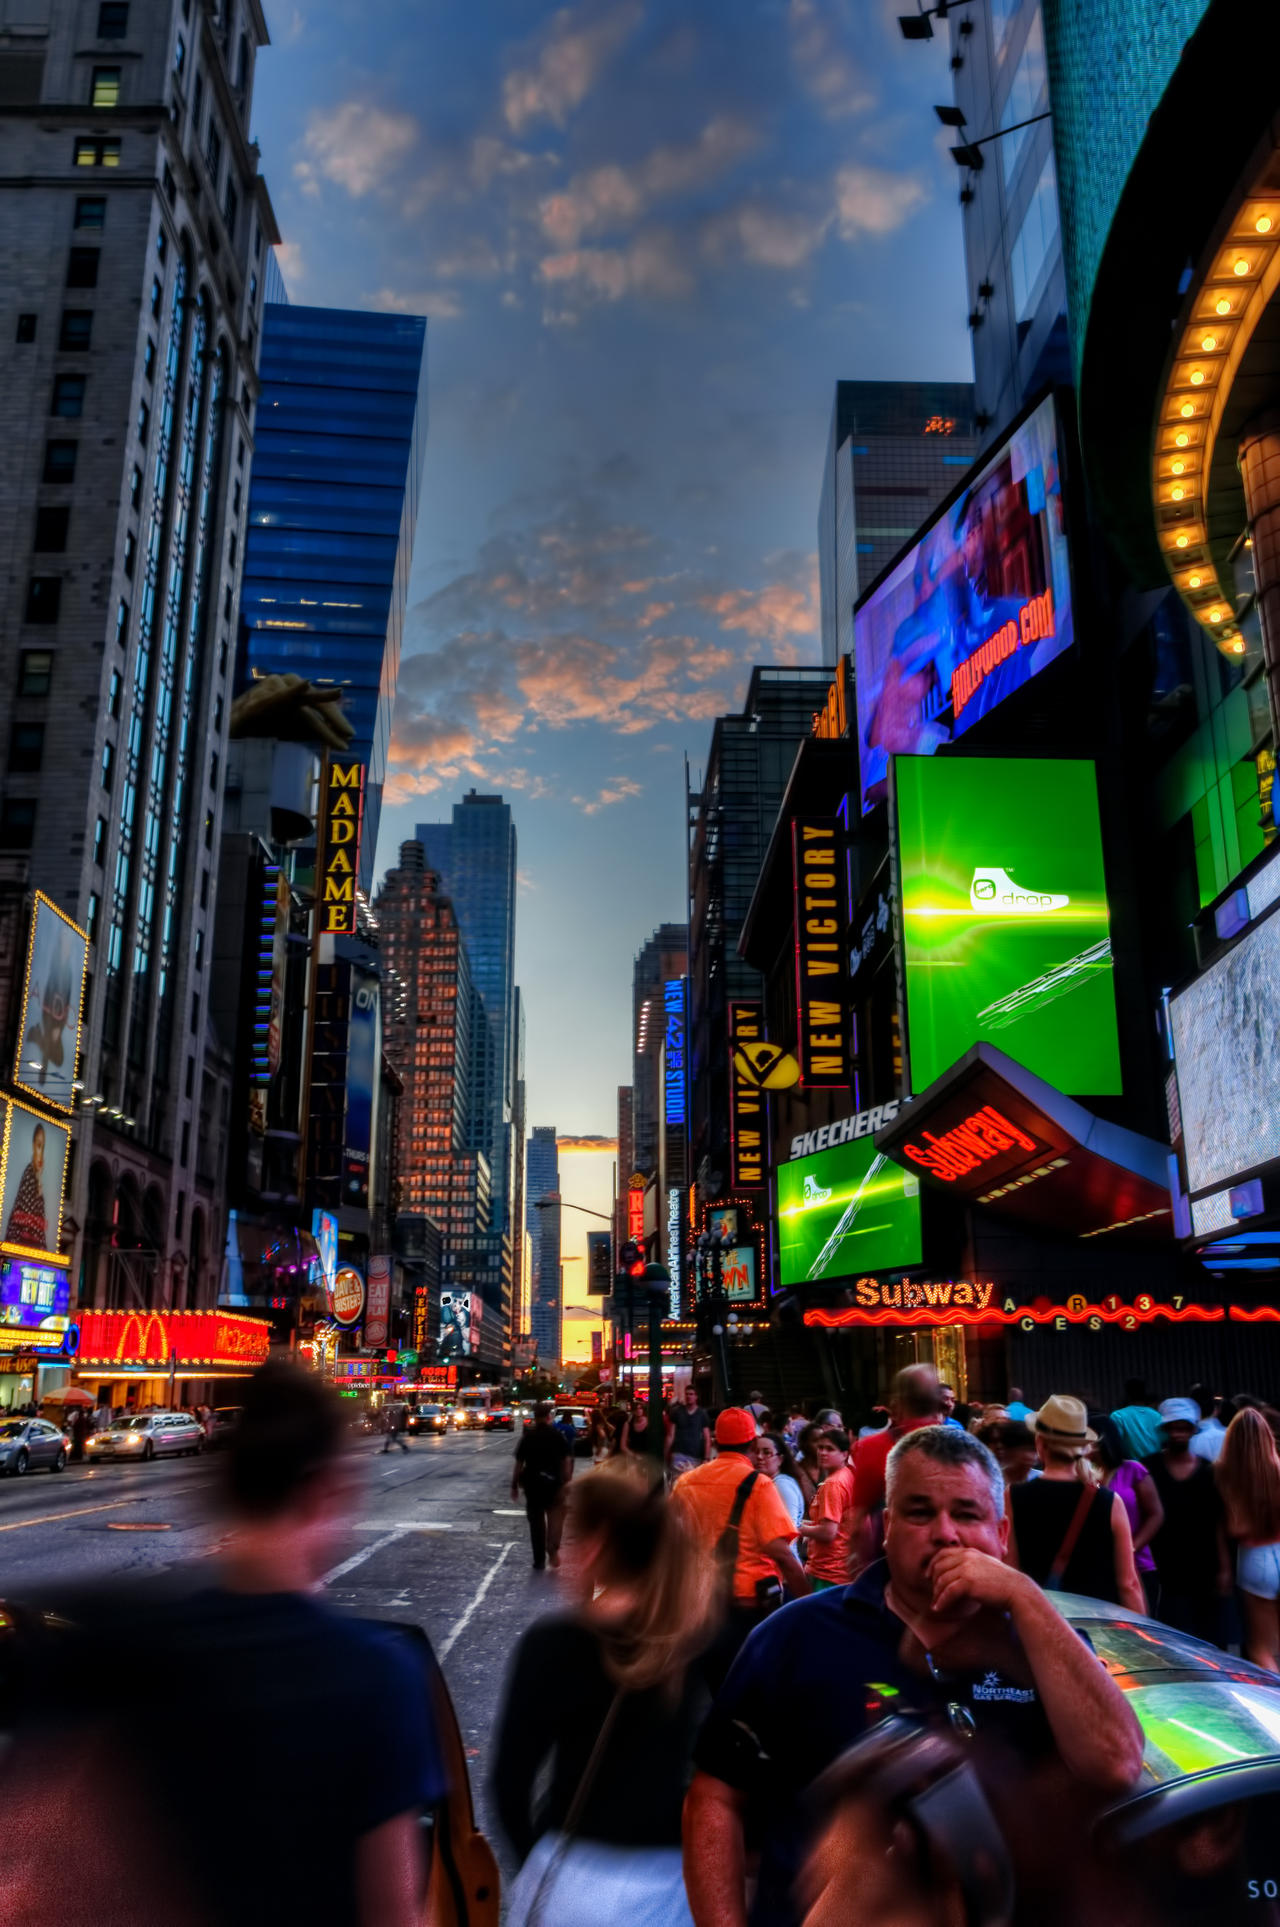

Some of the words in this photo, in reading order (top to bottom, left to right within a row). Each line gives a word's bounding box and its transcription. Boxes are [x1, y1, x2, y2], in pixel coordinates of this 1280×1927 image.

[322, 763, 360, 931] MADAME
[802, 825, 840, 977] VICTORY
[1002, 892, 1052, 908] drop
[664, 979, 684, 1013] NEW
[808, 1000, 843, 1076] NEW
[735, 1008, 761, 1115] VIRY
[789, 1099, 901, 1161] SKECHERS
[903, 1105, 1036, 1182] Subway
[738, 1130, 763, 1182] NEW
[334, 1279, 354, 1299] DAVE
[368, 1284, 387, 1298] EAT
[854, 1277, 994, 1309] Subway
[1004, 1298, 1016, 1312] A
[1073, 1296, 1083, 1310] R
[1108, 1297, 1117, 1310] 1
[1140, 1297, 1150, 1310] 3
[1172, 1297, 1184, 1310] 7
[367, 1305, 386, 1316] PLAY
[1021, 1317, 1034, 1331] C
[1056, 1317, 1067, 1331] E
[1089, 1317, 1102, 1331] S
[1125, 1317, 1136, 1330] 2
[972, 1683, 1035, 1697] NORTHEAST
[1247, 1879, 1278, 1899] SO
